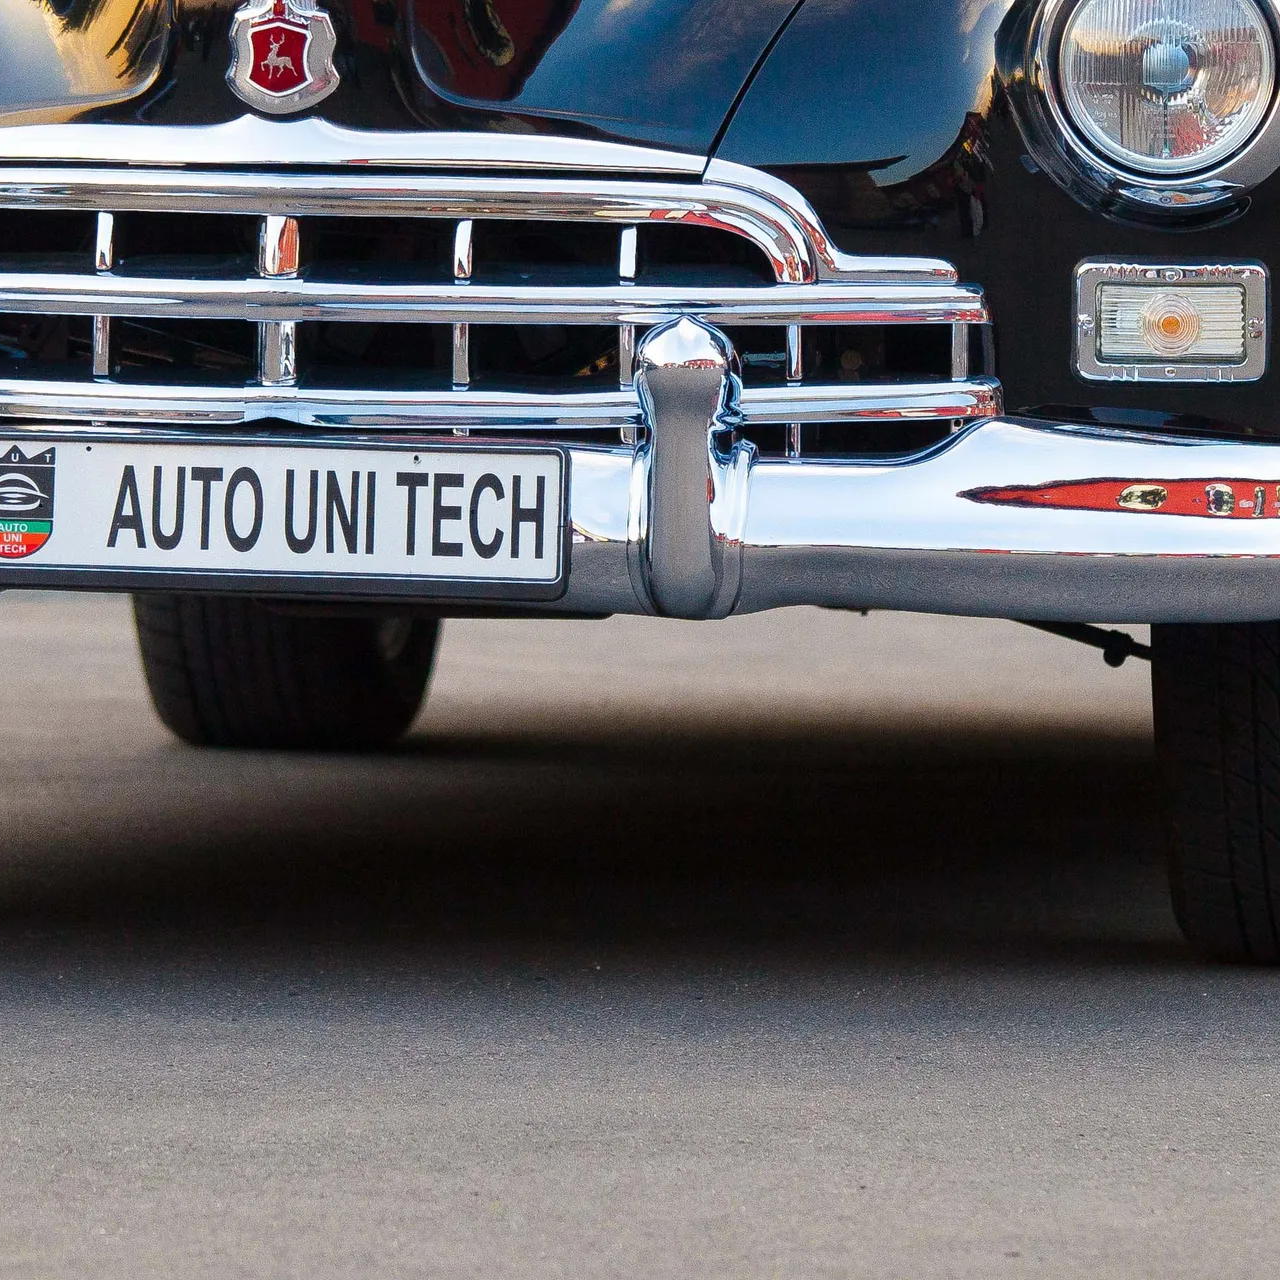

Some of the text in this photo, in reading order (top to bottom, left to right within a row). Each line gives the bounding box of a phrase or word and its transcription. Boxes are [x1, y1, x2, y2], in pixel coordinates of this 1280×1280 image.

[11, 453, 19, 462] U
[45, 454, 52, 463] T
[107, 465, 546, 559] AUTO UNI TECH
[3, 533, 23, 543] UNI
